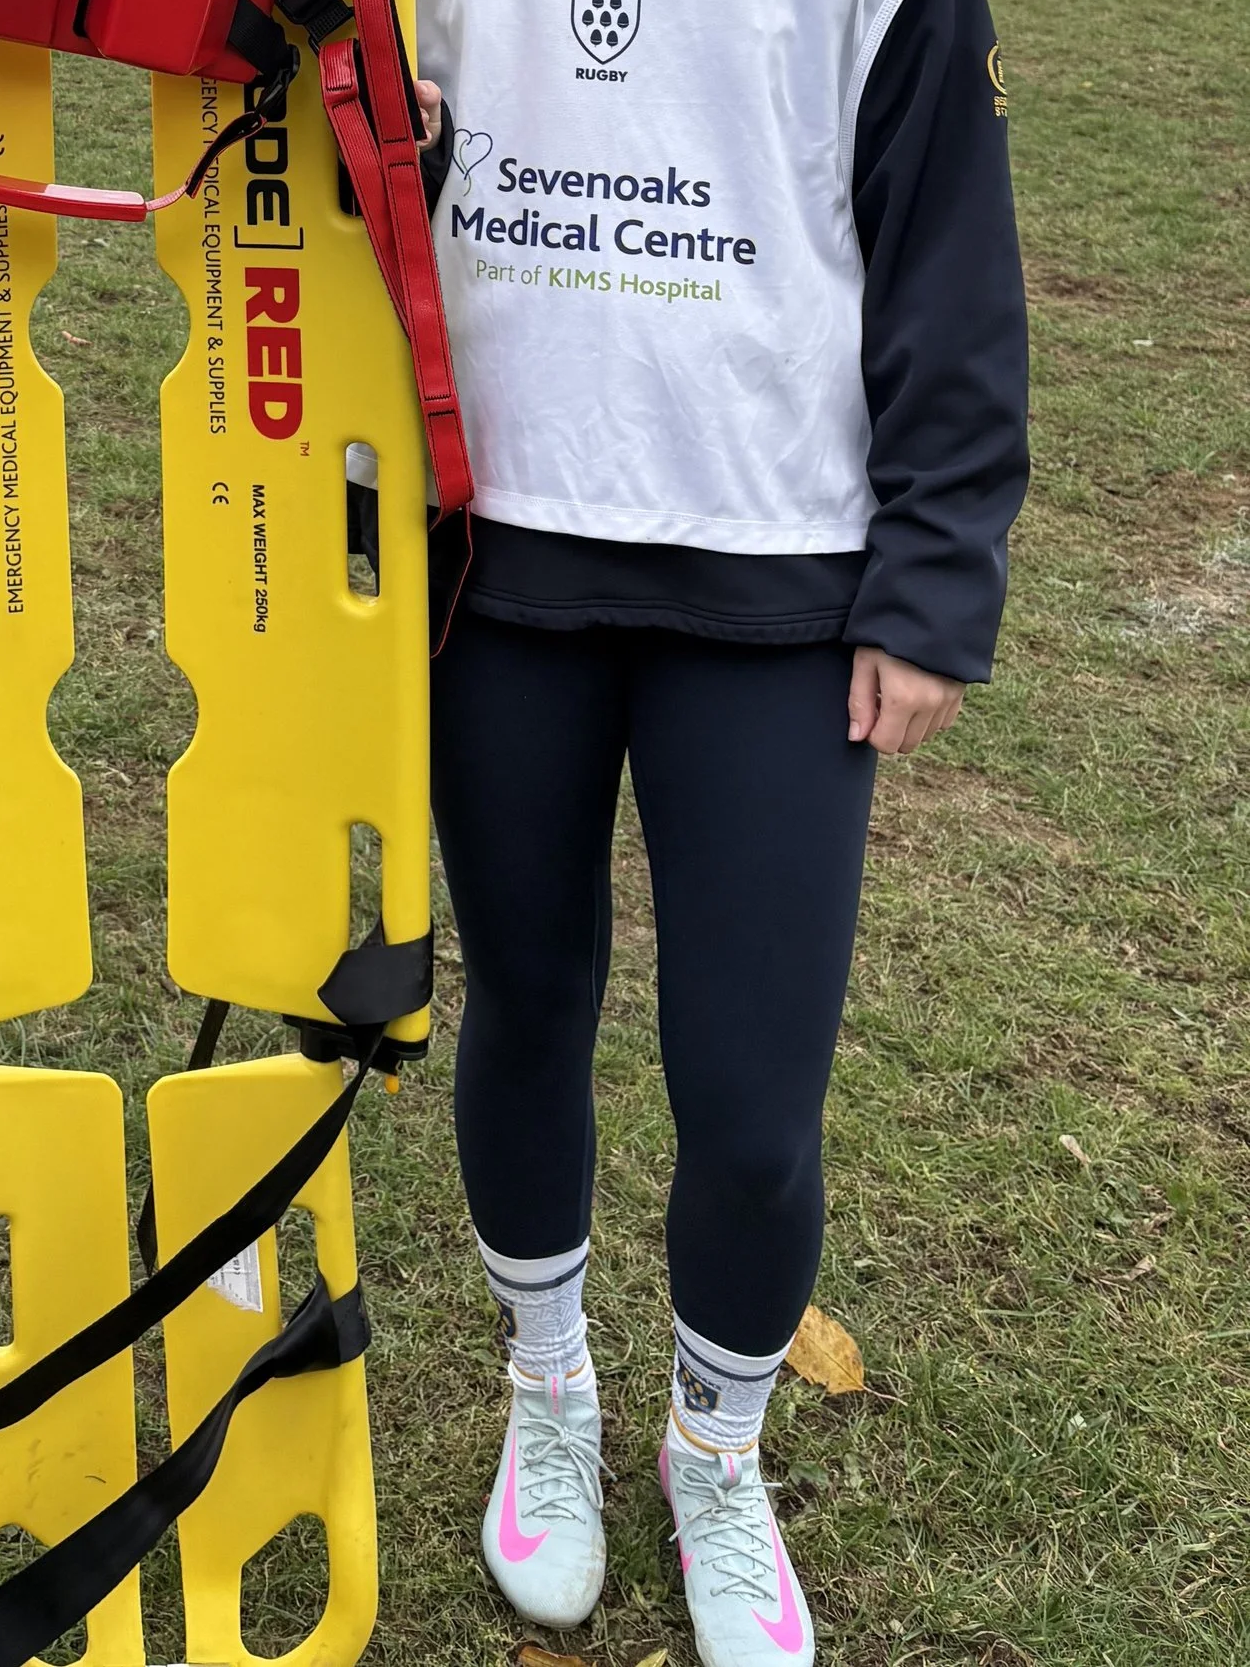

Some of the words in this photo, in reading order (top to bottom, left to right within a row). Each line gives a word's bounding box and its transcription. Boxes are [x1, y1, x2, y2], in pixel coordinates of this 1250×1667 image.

[575, 67, 628, 82] RUGBY
[497, 158, 711, 206] Sevenoaks
[451, 204, 600, 252] Medical
[614, 219, 757, 265] Centre
[202, 224, 223, 330] EQUIPMENT
[476, 259, 515, 282] Part
[521, 265, 542, 285] of
[549, 267, 611, 291] KIMS
[621, 273, 722, 303] Hospital
[208, 337, 223, 351] &
[245, 267, 303, 440] RED
[208, 357, 226, 434] SUPPLIES
[1, 420, 19, 499] MEDICAL
[252, 484, 266, 519] MAX
[4, 505, 24, 614] EMERGENCY
[253, 523, 268, 585] WEIGHT
[254, 589, 268, 633] 250kg
